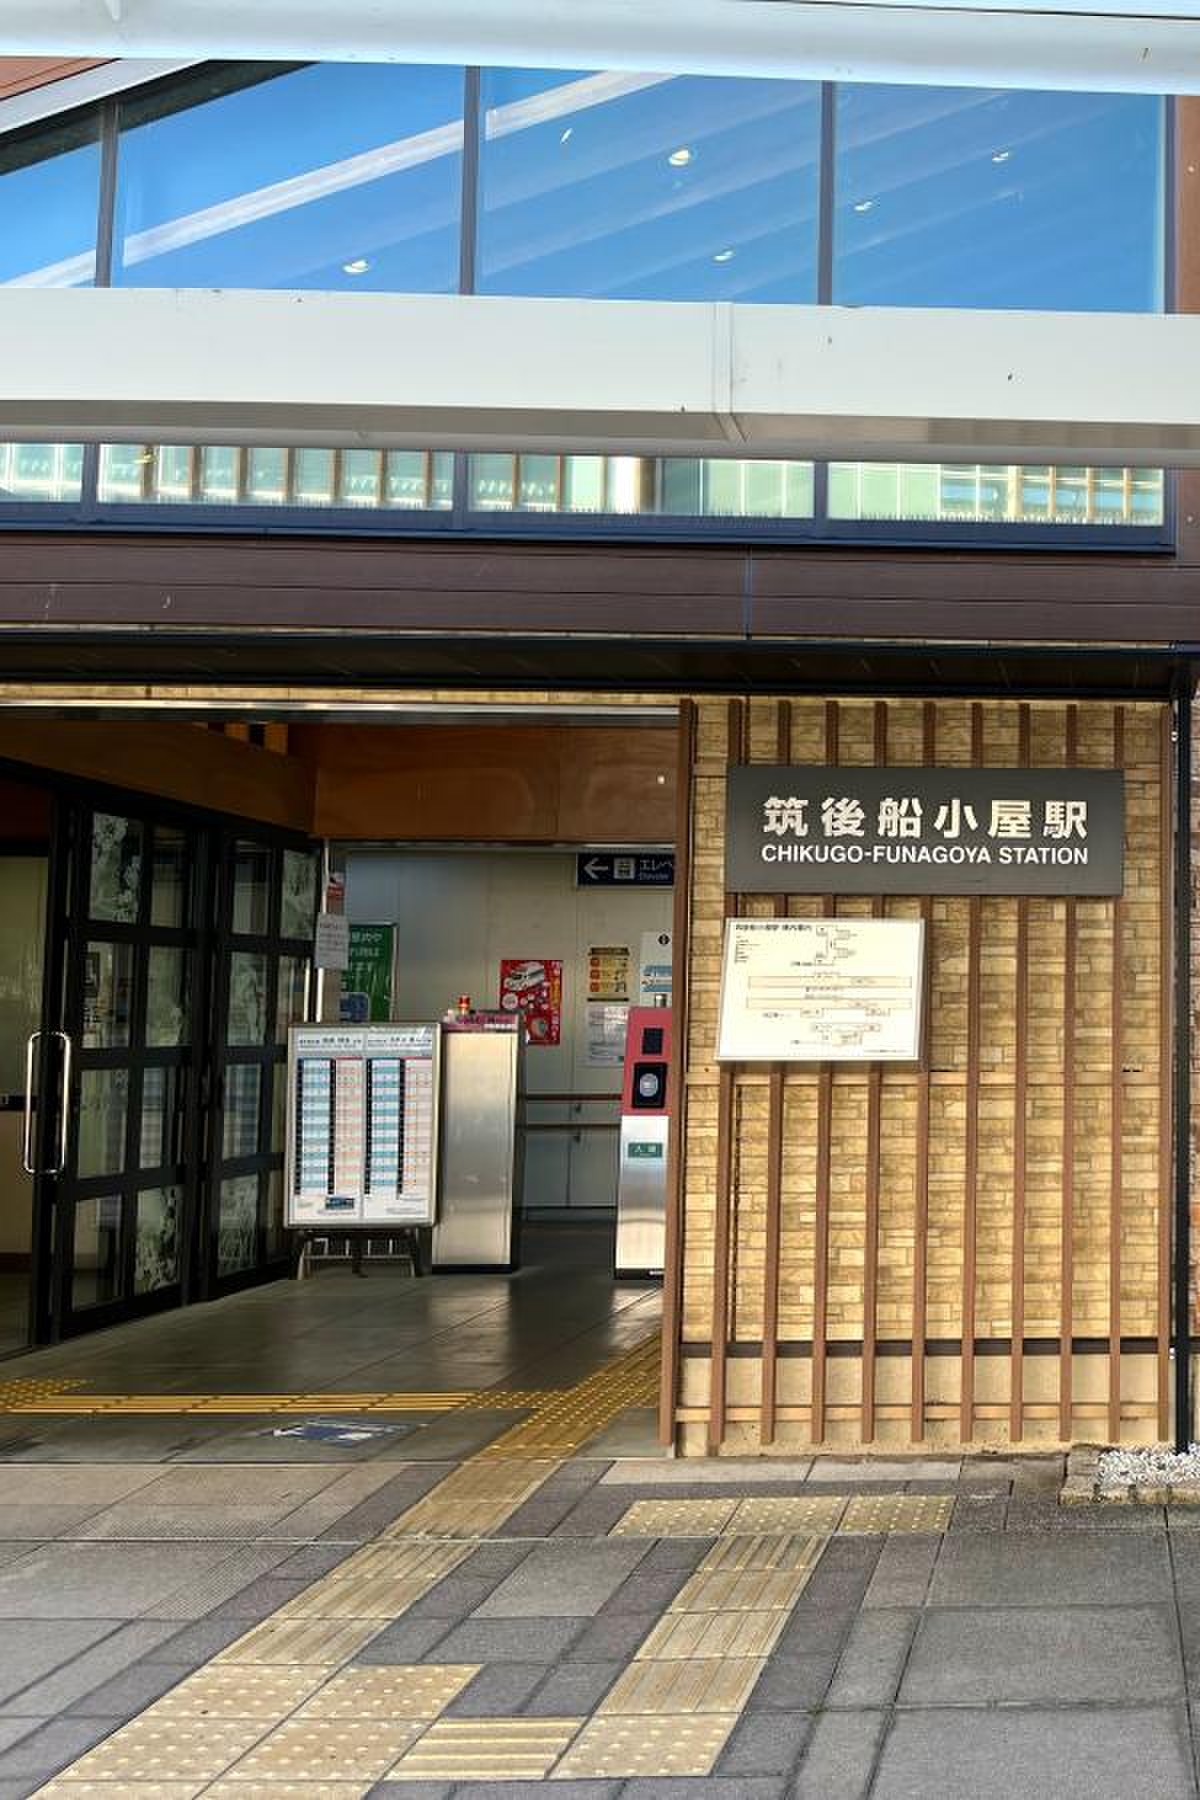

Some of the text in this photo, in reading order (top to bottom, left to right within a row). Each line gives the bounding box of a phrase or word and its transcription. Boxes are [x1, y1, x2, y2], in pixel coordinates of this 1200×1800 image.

[763, 797, 1088, 839] 筑後船小屋駅
[762, 844, 1088, 865] CHIKUGO-FUNAGOYA STATION
